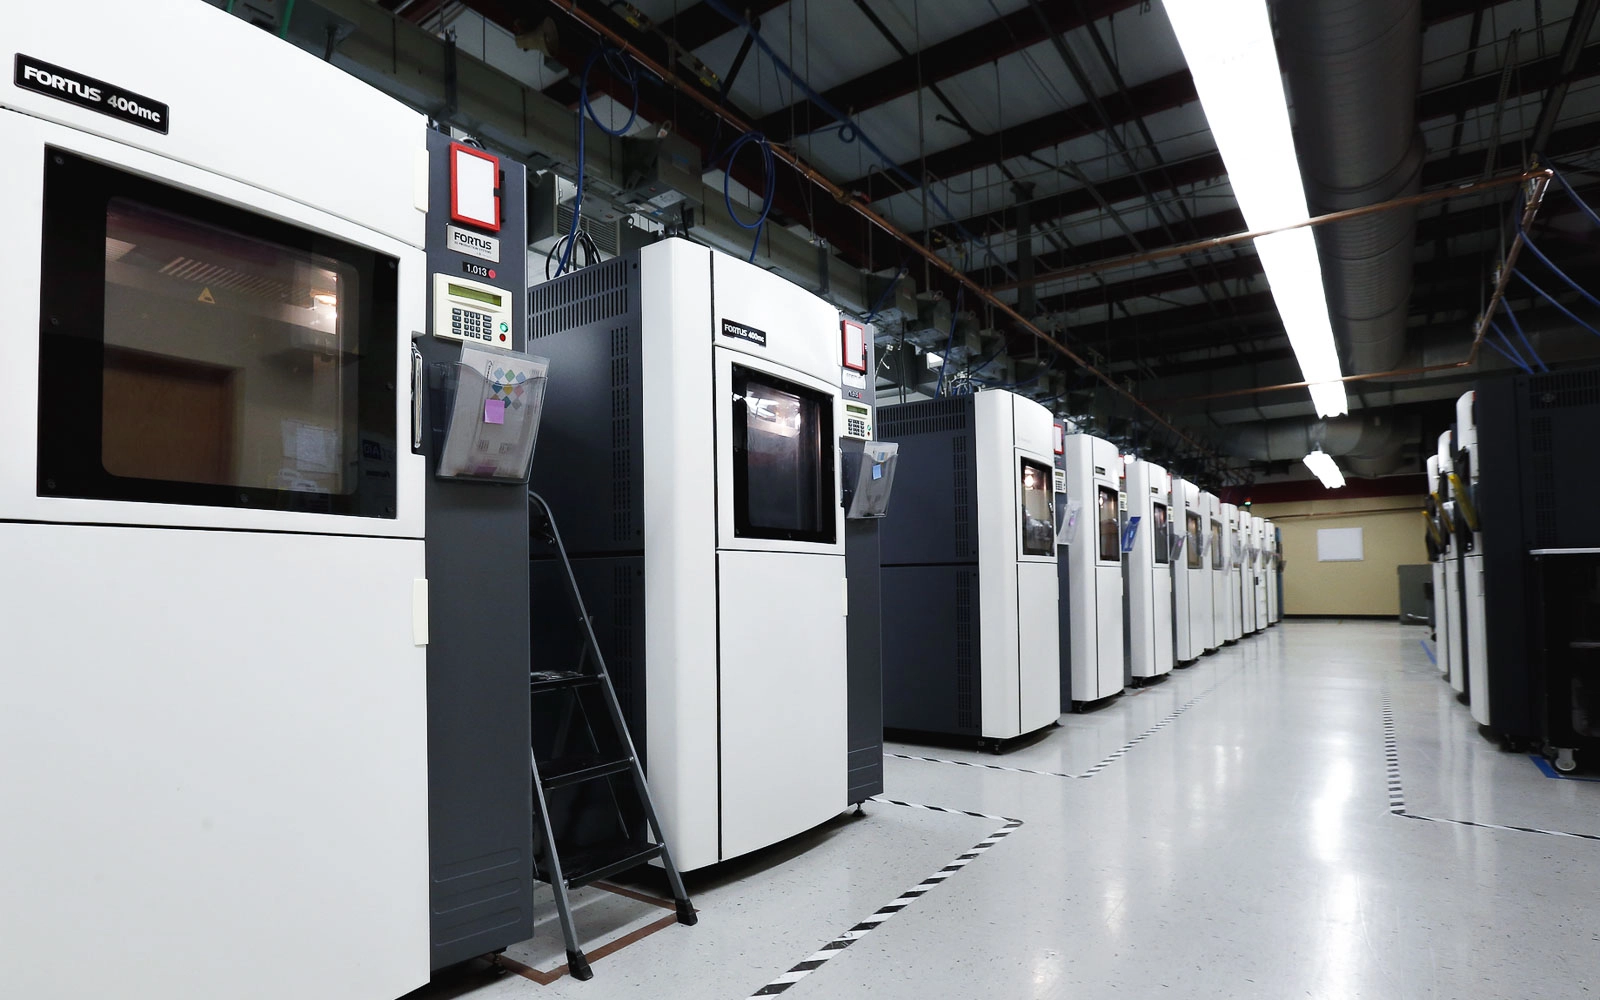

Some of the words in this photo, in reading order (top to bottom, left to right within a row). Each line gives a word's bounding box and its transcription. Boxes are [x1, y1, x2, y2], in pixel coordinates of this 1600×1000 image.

[24, 65, 102, 102] FORTUS
[107, 94, 161, 123] 400mc
[454, 231, 492, 250] FORTUS
[466, 264, 488, 277] 1.013
[724, 323, 748, 337] FORTUS
